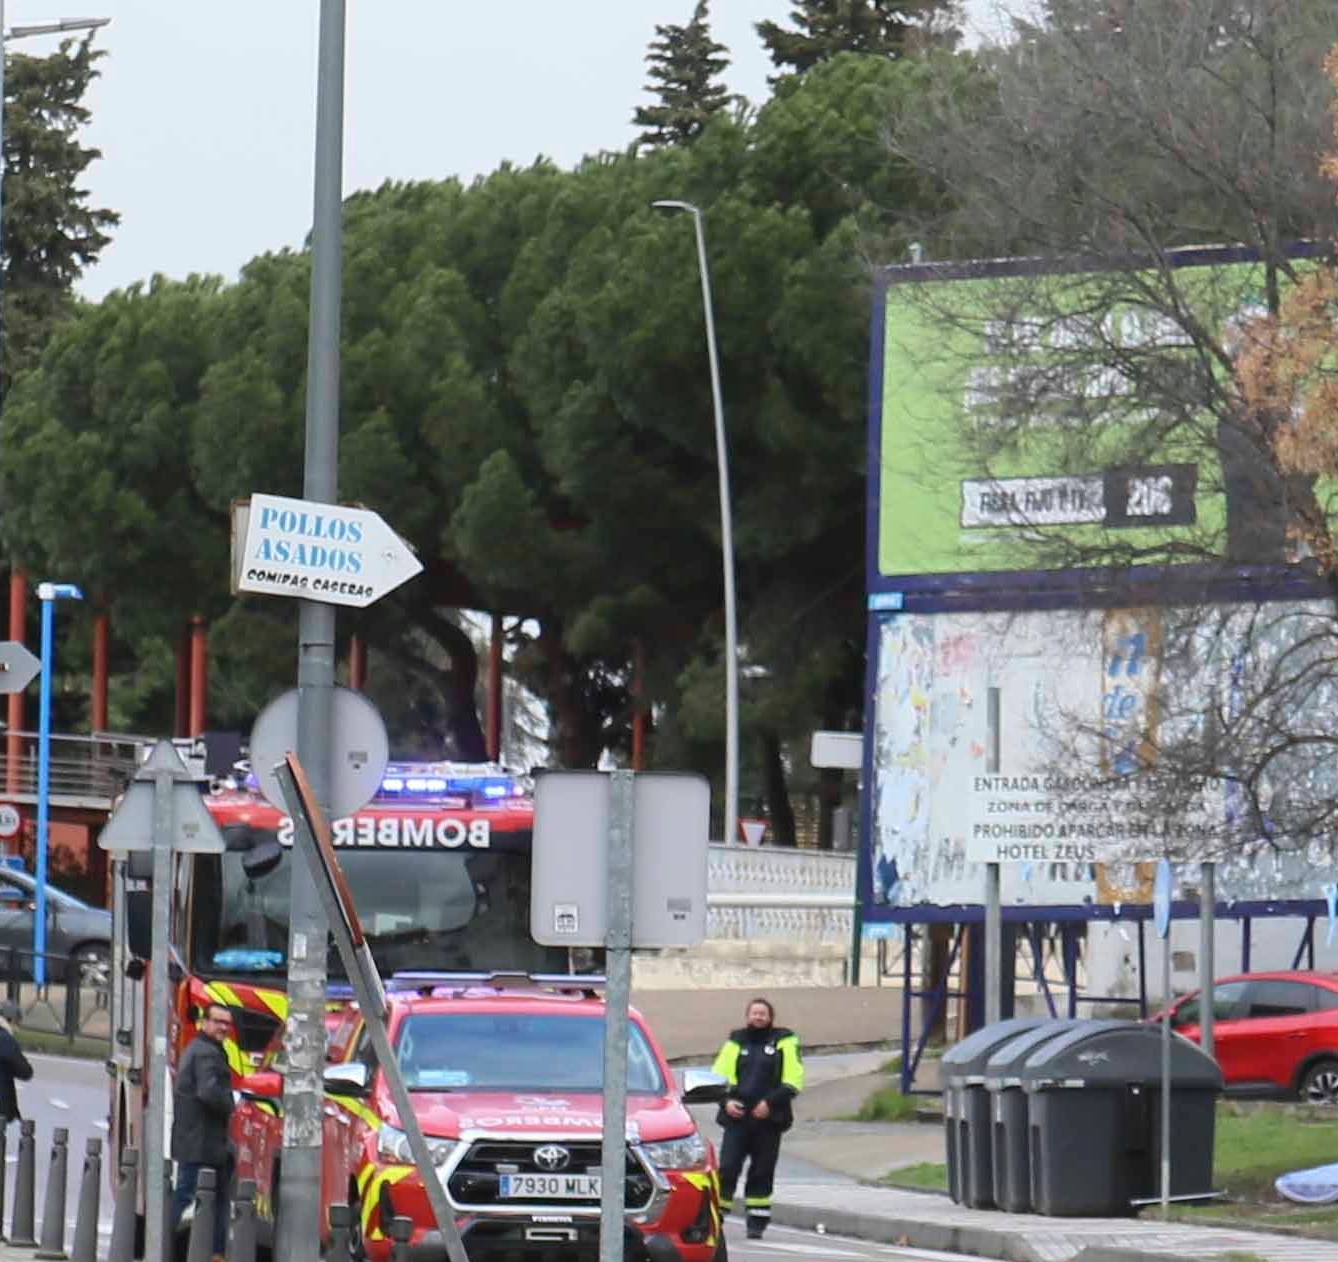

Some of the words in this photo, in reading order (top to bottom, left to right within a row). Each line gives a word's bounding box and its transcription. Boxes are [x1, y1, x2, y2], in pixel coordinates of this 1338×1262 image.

[260, 507, 363, 544] POLLOS
[255, 538, 363, 574] ASADOS
[246, 568, 309, 588] COMIDAS
[312, 578, 374, 598] CASERAS
[973, 777, 1040, 793] ENTRADA
[988, 801, 1030, 814] ZONA
[1035, 801, 1054, 814] DE
[973, 824, 1055, 839] PROHIBIDO
[996, 844, 1048, 860] HOTEL
[1055, 844, 1095, 860] ZEUS
[513, 1177, 559, 1195] 7930
[565, 1176, 600, 1195] MLK
